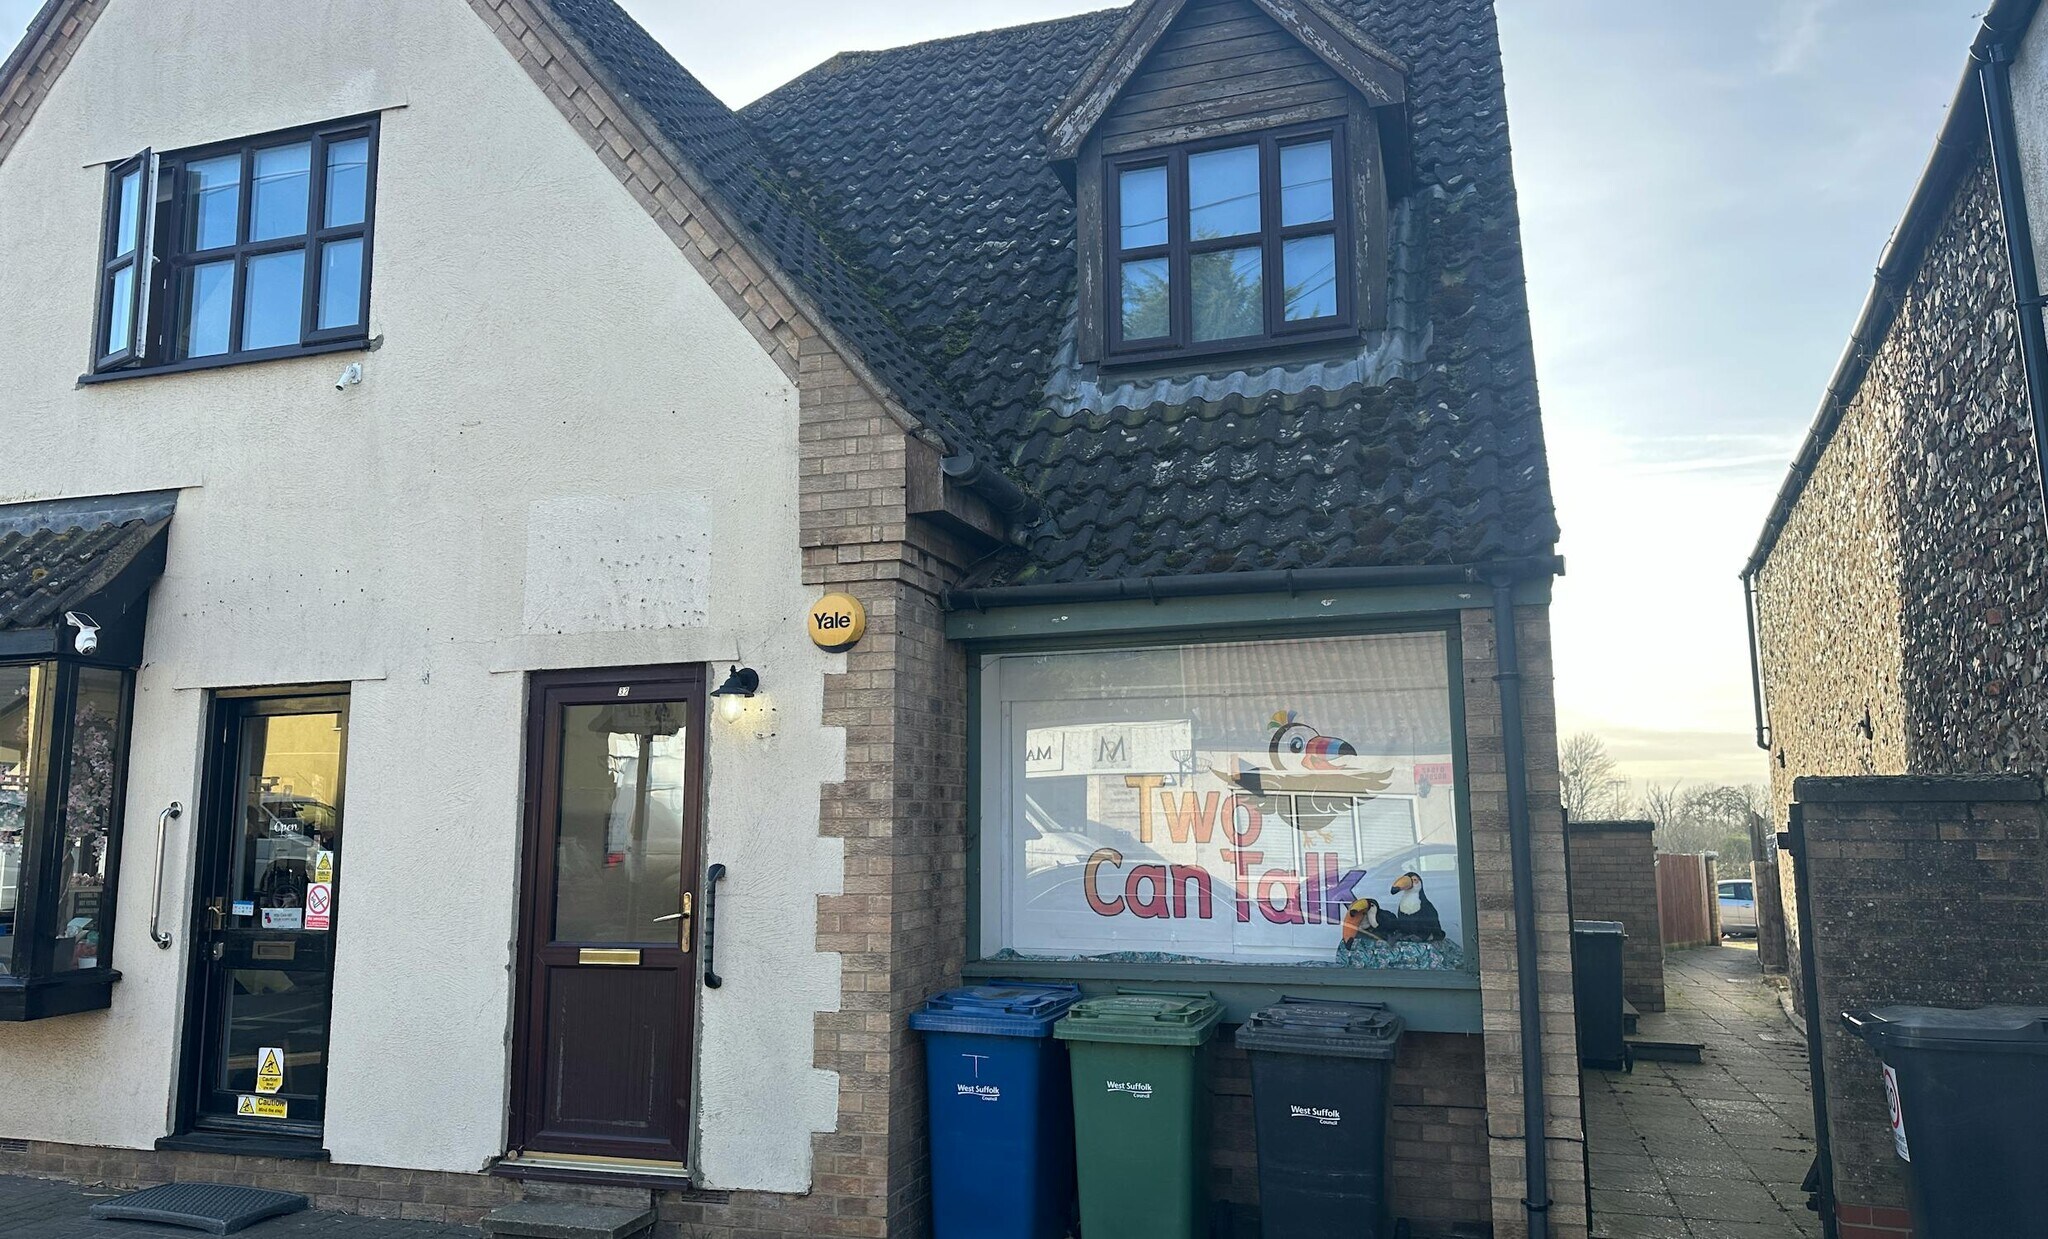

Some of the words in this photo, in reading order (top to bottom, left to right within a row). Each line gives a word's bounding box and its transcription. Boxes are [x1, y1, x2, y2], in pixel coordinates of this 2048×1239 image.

[813, 611, 851, 630] Yale
[1124, 774, 1263, 847] Two
[273, 820, 300, 835] Open
[1083, 847, 1213, 920] Can
[1219, 848, 1367, 925] Talk
[957, 1084, 975, 1093] West
[975, 1085, 1000, 1094] Suffolk
[1106, 1080, 1125, 1089] West
[1126, 1082, 1152, 1091] Suffolk
[1290, 1104, 1311, 1115] West
[1312, 1107, 1340, 1118] Suffolk
